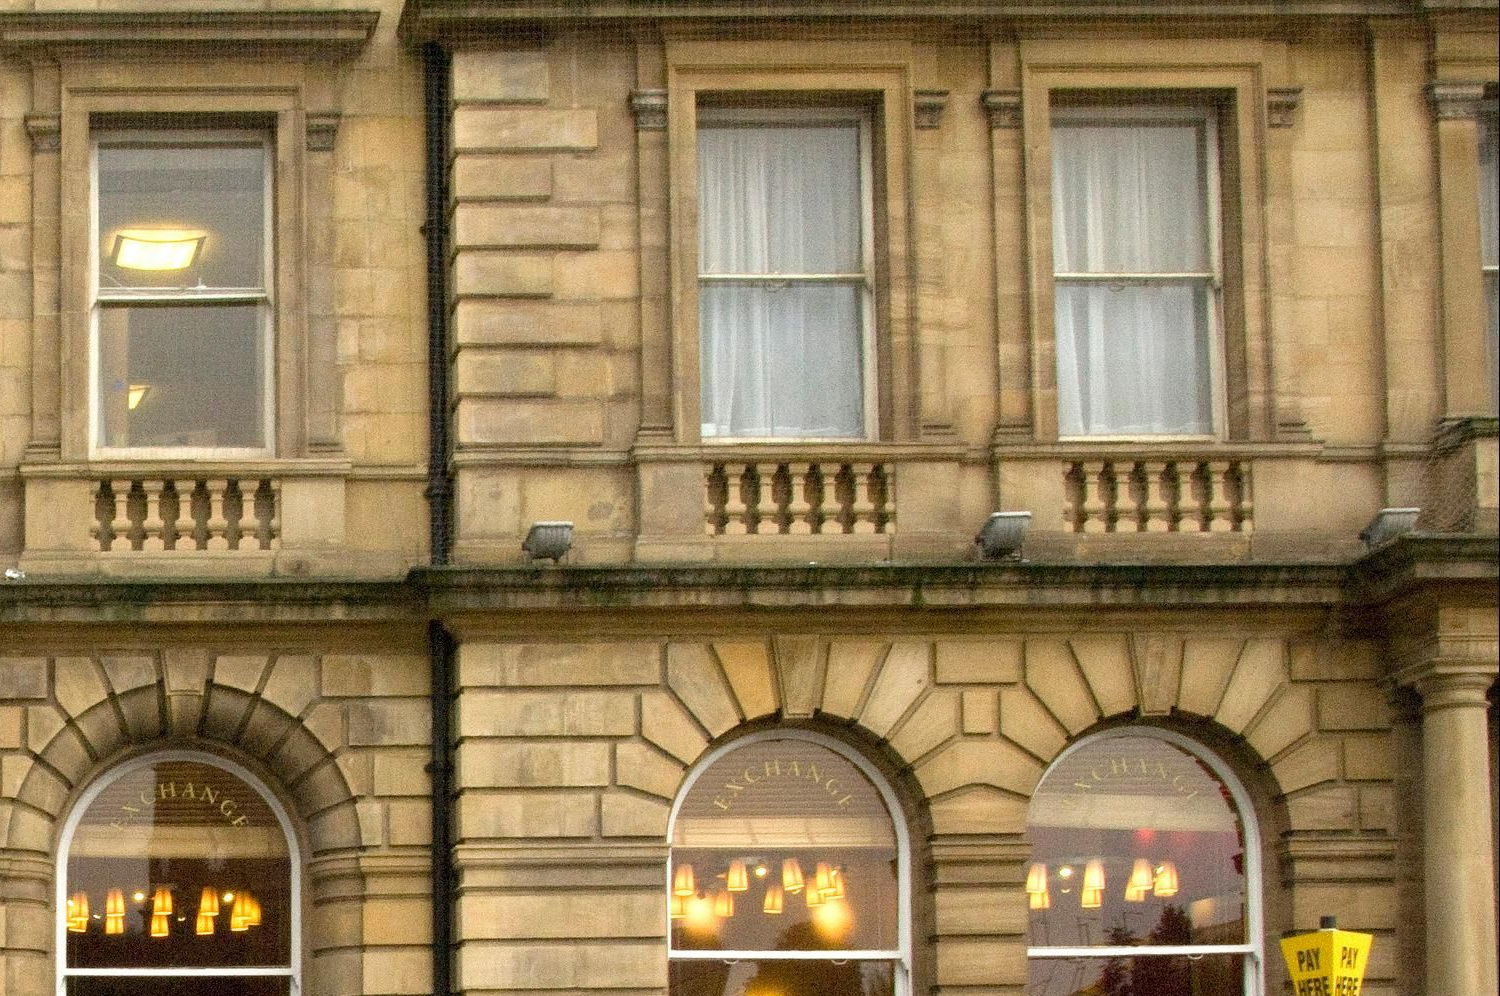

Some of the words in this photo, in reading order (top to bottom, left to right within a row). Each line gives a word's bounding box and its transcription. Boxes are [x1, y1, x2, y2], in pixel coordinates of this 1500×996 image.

[713, 760, 852, 810] EXCHANGE
[1063, 757, 1199, 806] XCHANG
[1297, 947, 1320, 972] PAY
[1340, 946, 1359, 969] PAY
